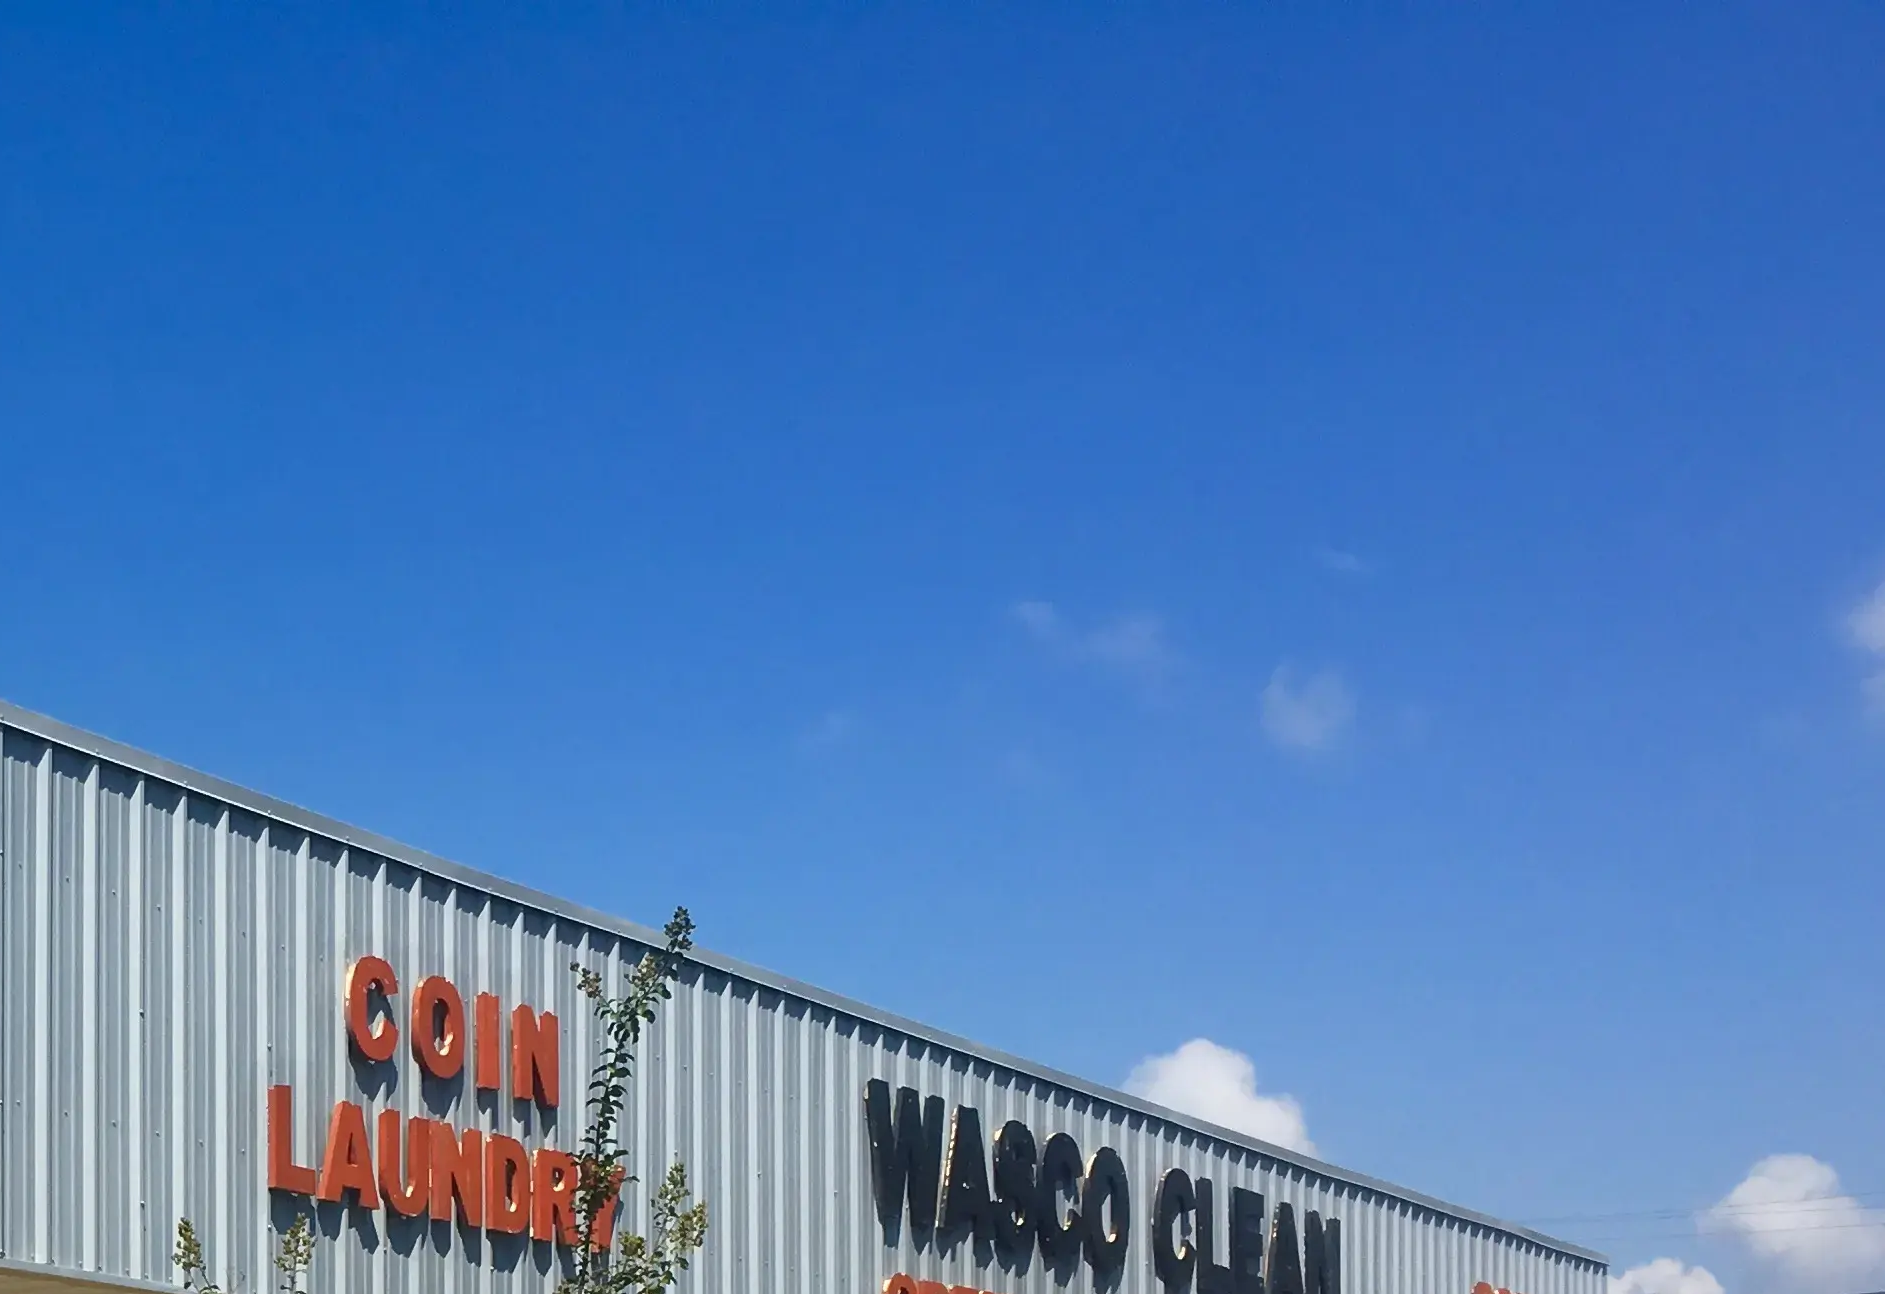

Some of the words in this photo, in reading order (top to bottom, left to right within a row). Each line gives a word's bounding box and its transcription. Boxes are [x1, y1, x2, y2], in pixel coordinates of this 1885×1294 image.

[344, 955, 560, 1109] COIN
[267, 1084, 627, 1254] LAUNDRY
[863, 1077, 1131, 1275] WASCO
